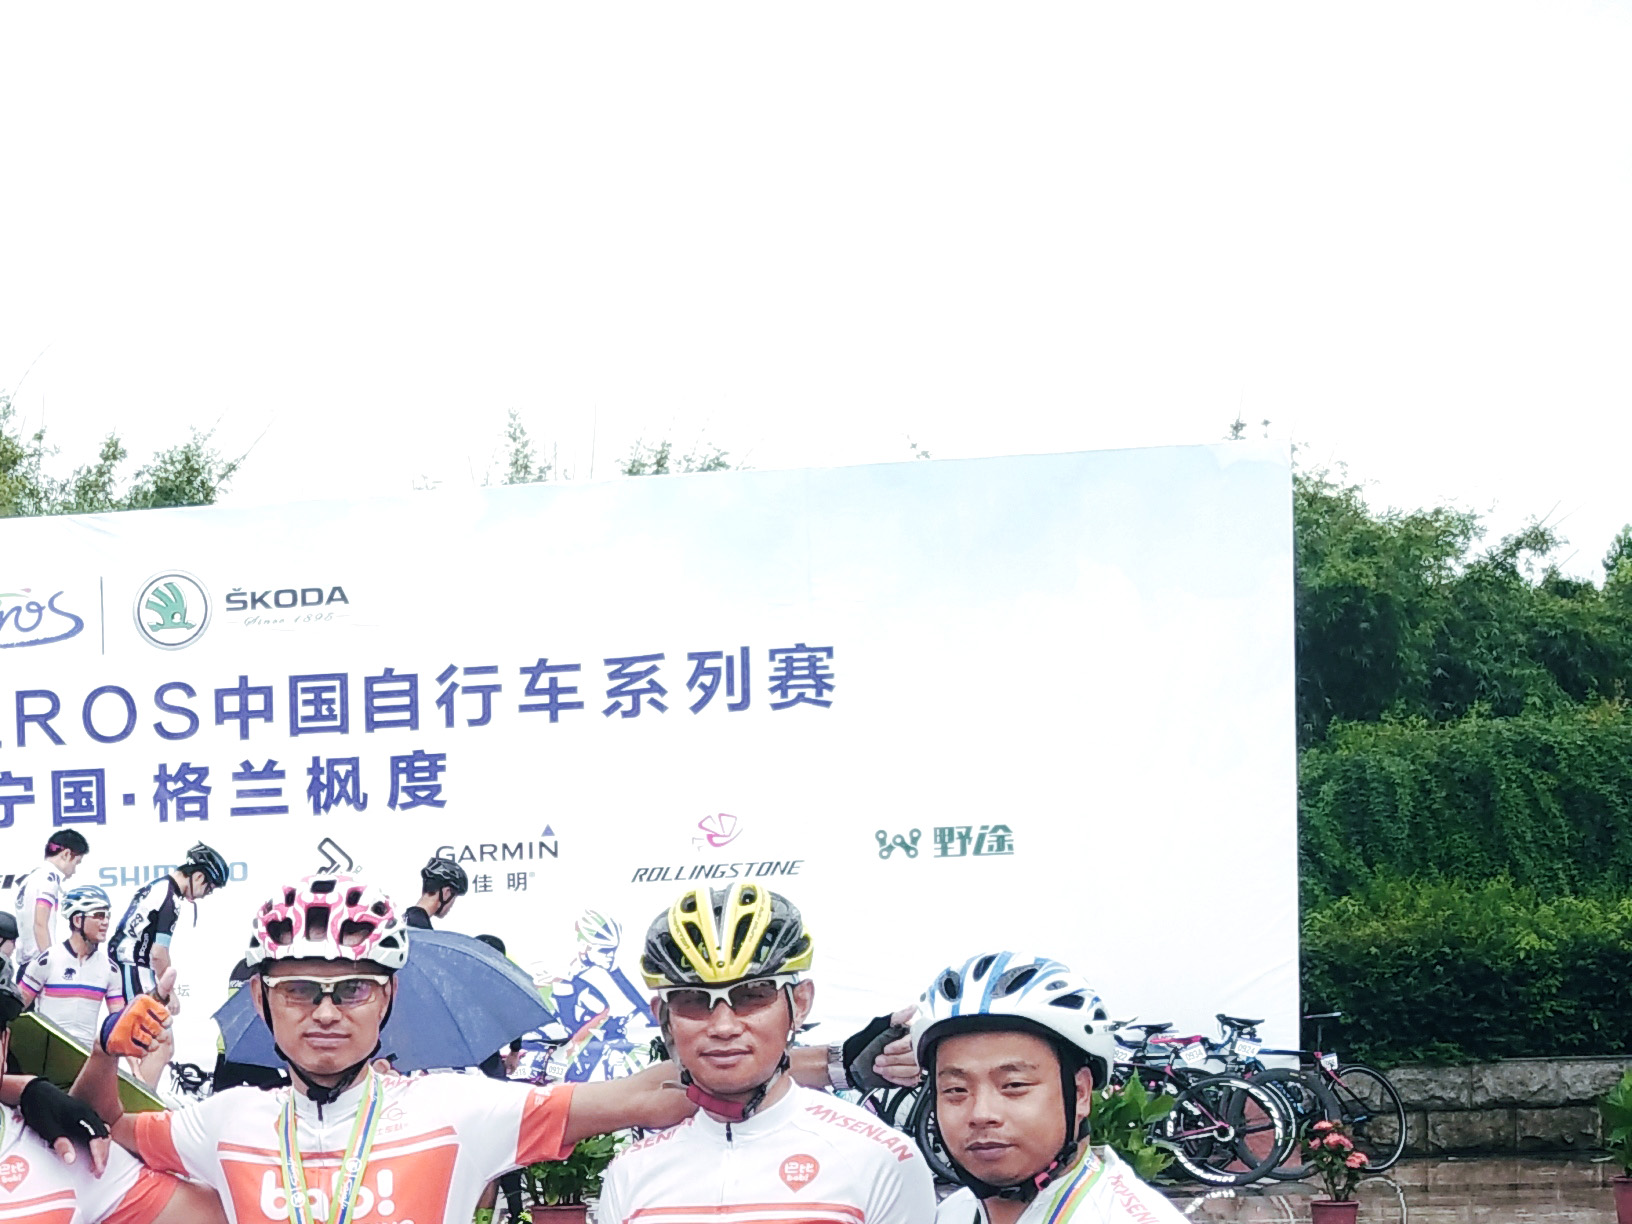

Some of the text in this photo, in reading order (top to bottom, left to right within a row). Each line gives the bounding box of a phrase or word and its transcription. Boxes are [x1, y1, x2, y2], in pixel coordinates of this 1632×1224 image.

[435, 839, 559, 864] GARMIN
[933, 824, 1015, 858] 野途
[99, 862, 248, 888] SHIMO
[472, 872, 528, 893] 佳明
